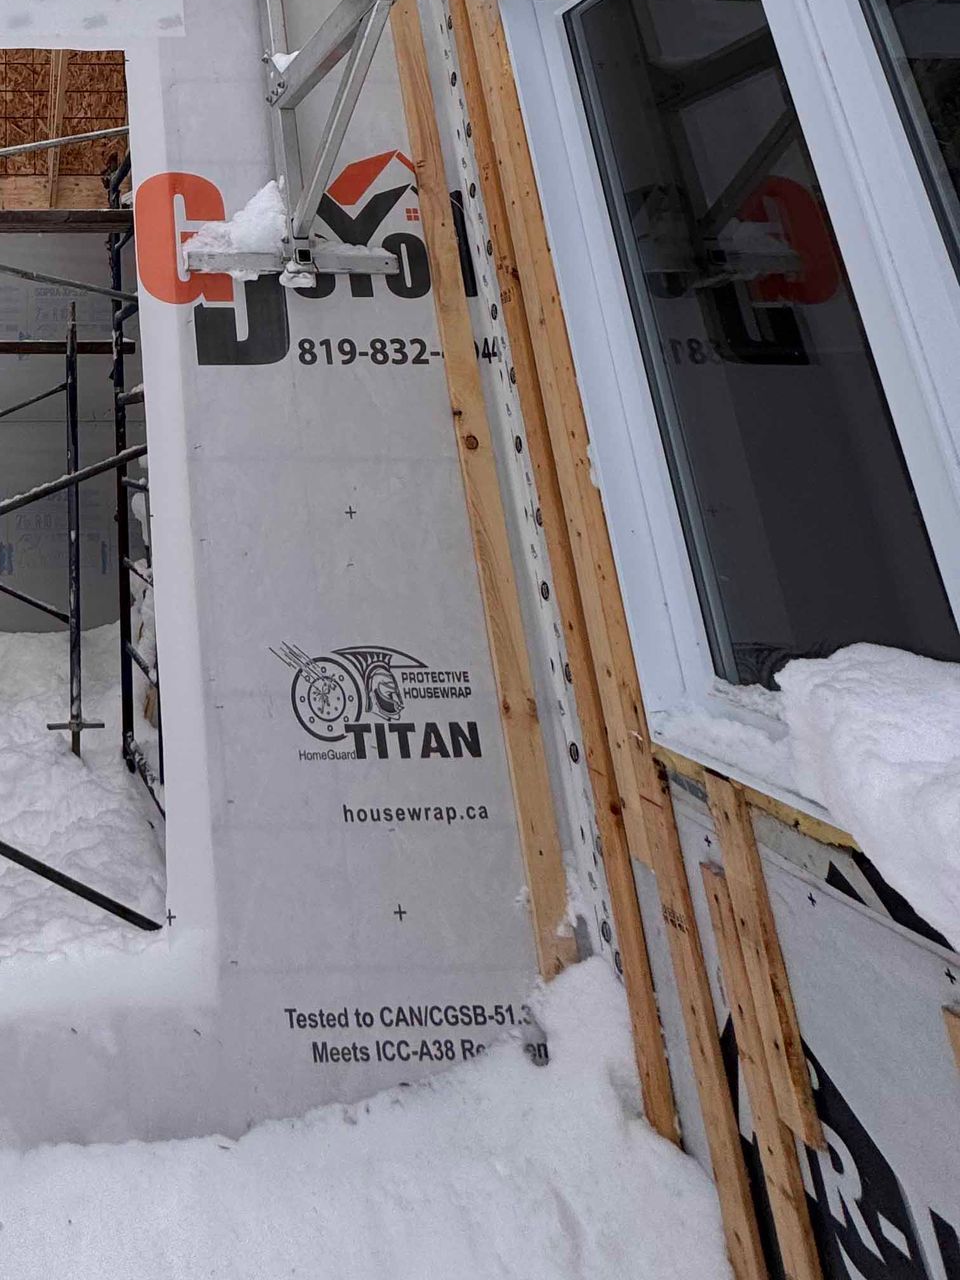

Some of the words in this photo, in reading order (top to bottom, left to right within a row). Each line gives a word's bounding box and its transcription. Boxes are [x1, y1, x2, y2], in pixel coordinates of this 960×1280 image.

[298, 337, 503, 365] 819-832-44
[401, 671, 470, 684] PROTECTIVE
[403, 686, 472, 699] HOUSEWRAP
[344, 721, 482, 759] TITAN
[298, 749, 356, 761] HomeGuard
[342, 804, 489, 824] housewrap.ca
[284, 1007, 349, 1030] Tested
[354, 1007, 374, 1028] to
[379, 1004, 533, 1027] CAN/CGSB-51.3
[311, 1041, 371, 1064] Meets
[375, 1039, 456, 1062] ICC-A38
